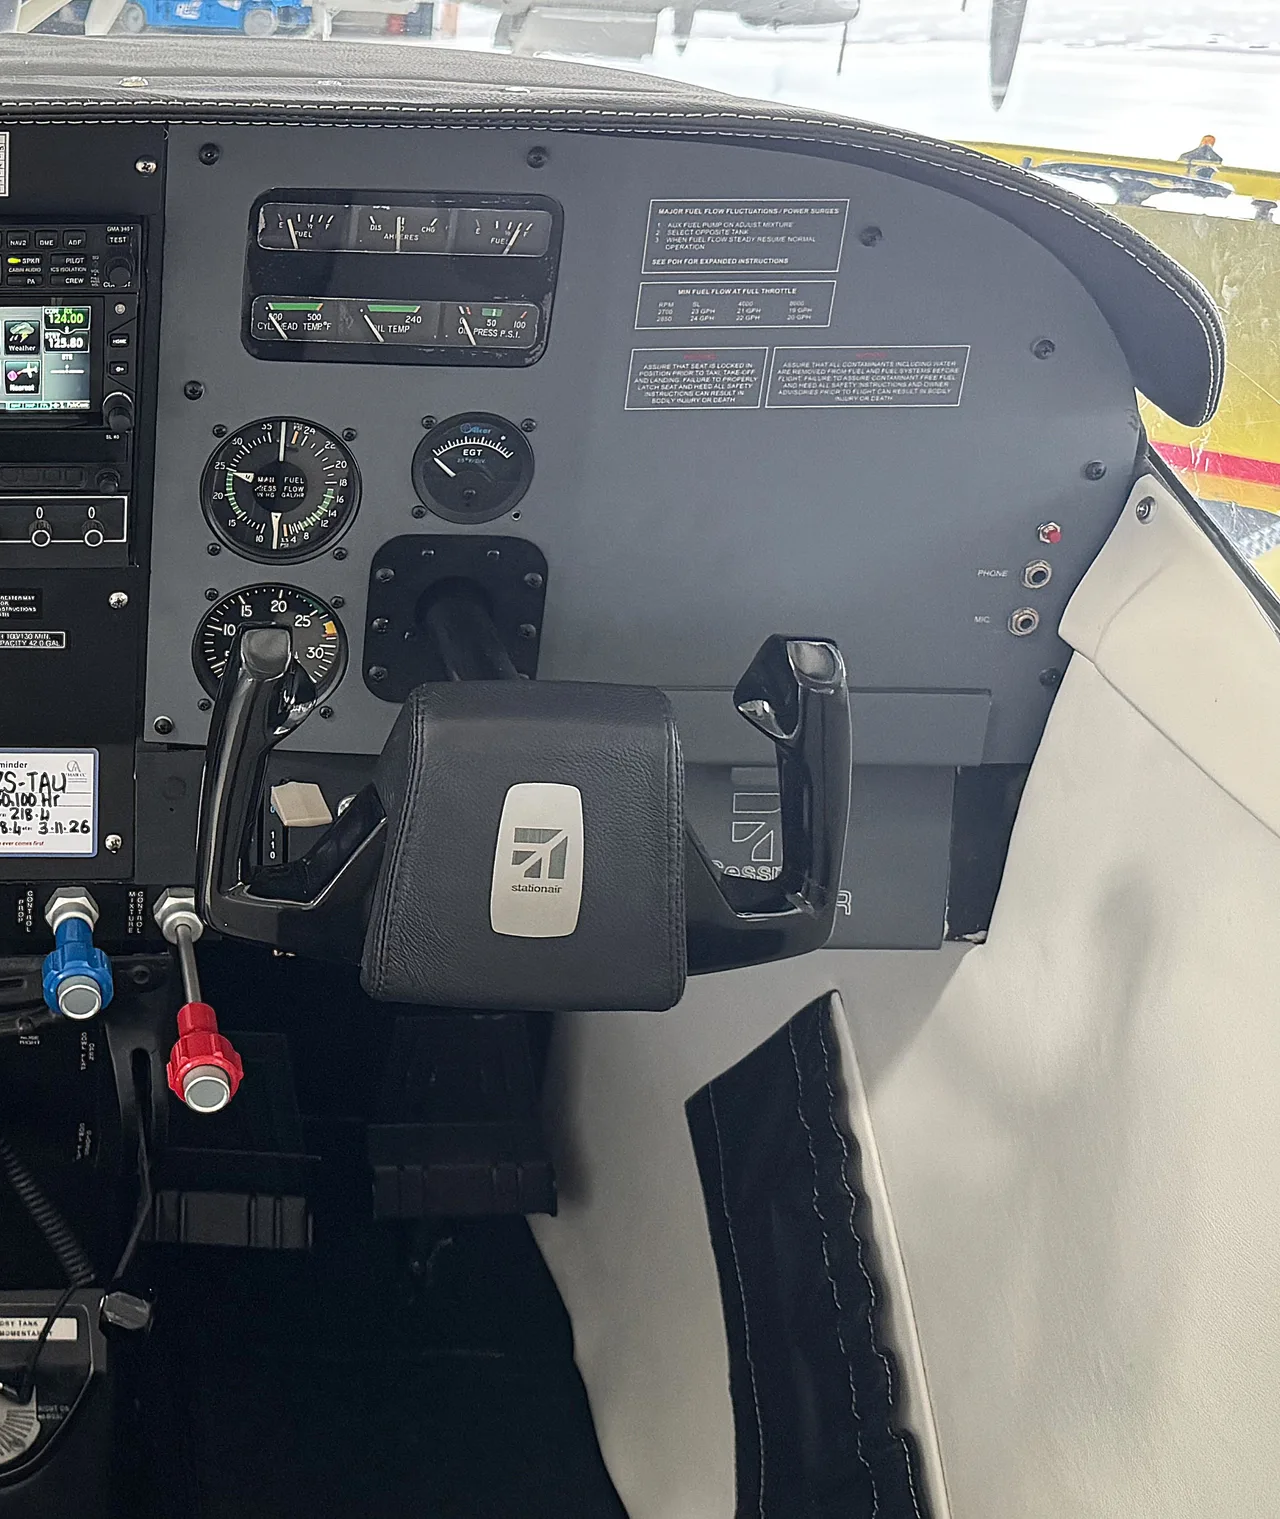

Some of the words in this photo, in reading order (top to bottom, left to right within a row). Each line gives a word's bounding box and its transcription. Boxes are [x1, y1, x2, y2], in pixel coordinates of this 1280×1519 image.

[421, 225, 436, 233] CHG
[294, 230, 313, 238] FUEL
[48, 313, 84, 324] 124.00
[307, 313, 322, 321] 500
[405, 315, 422, 324] 240
[486, 318, 497, 327] 50
[513, 320, 526, 329] 100
[388, 324, 410, 334] TEMP
[473, 328, 498, 338] PRESS
[48, 337, 84, 349] 125.80
[8, 344, 36, 352] Weather
[214, 461, 226, 471] 25
[335, 461, 347, 470] 20
[284, 476, 305, 484] FUEL
[339, 478, 348, 487] 18
[212, 492, 224, 501] 20
[336, 495, 345, 504] 16
[227, 519, 236, 528] 15
[255, 535, 264, 543] 10
[977, 570, 1008, 578] PHONE
[270, 599, 288, 613] 20
[240, 604, 253, 618] 15
[294, 614, 312, 628] 25
[974, 616, 990, 624] MIC
[223, 625, 236, 636] 10
[305, 647, 324, 659] 30
[511, 884, 562, 894] stationair
